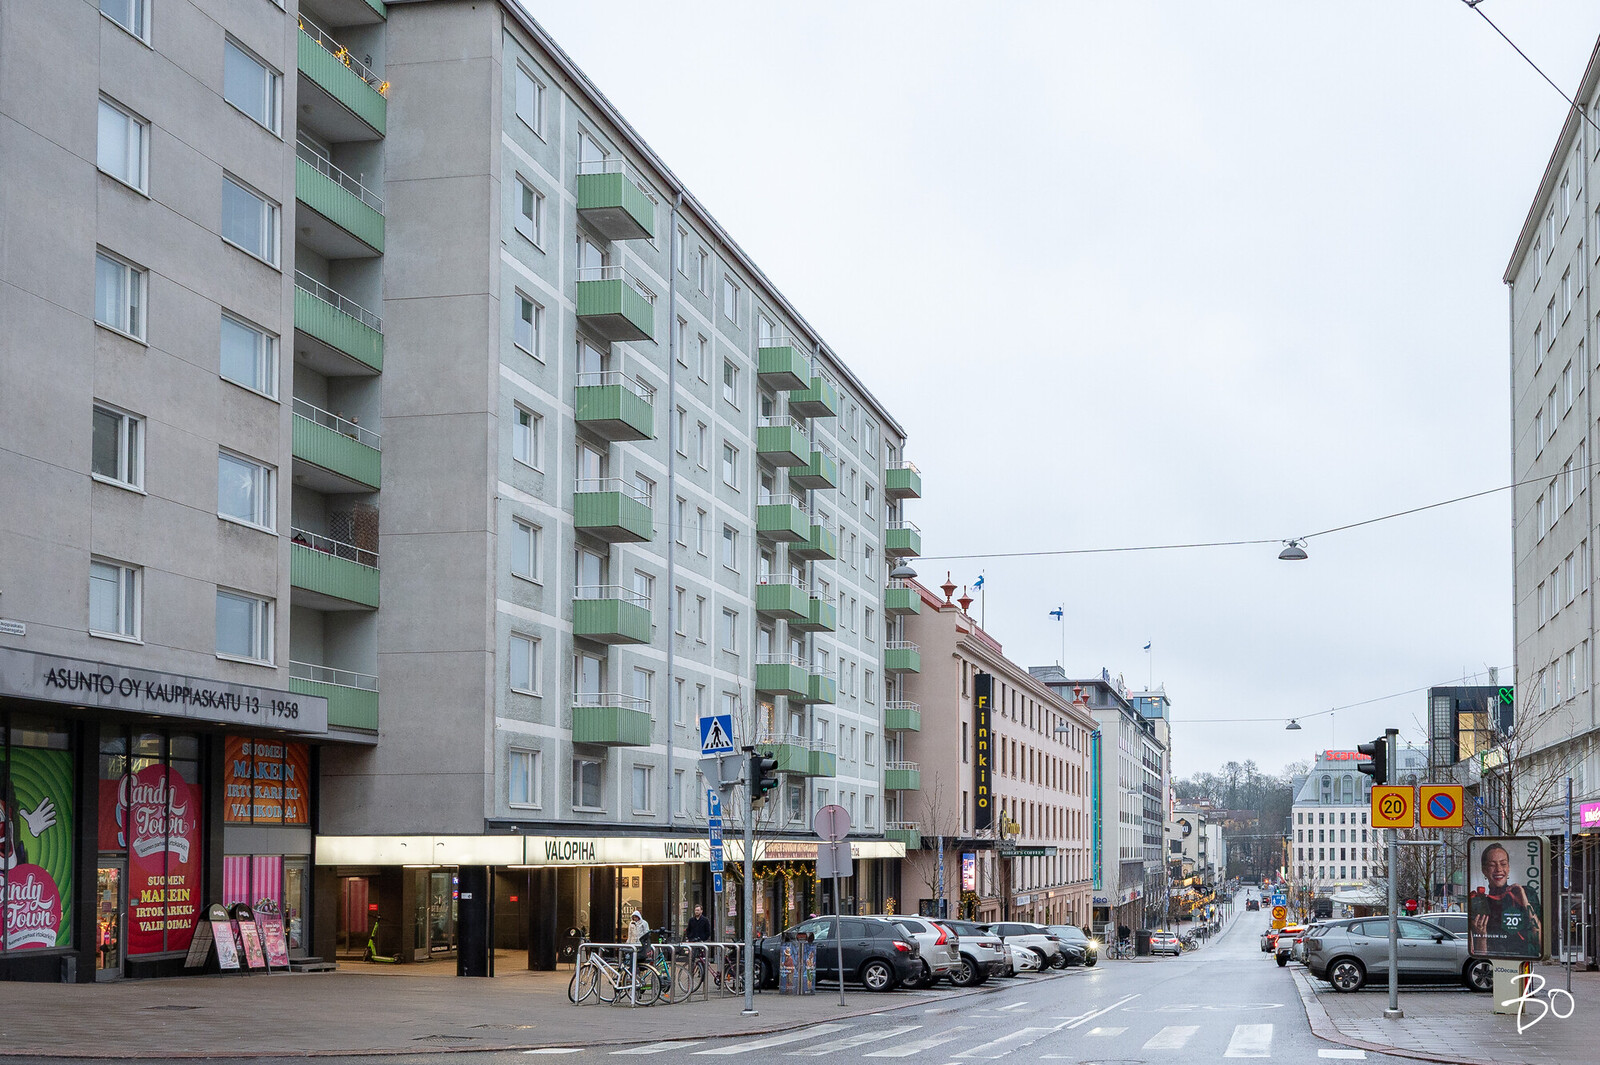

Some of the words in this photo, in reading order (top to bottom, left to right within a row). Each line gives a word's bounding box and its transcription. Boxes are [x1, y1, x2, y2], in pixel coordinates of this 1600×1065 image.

[45, 667, 114, 695] ASUNTO
[119, 678, 142, 698] OY
[146, 681, 240, 712] KAUPPIASKATU
[246, 696, 260, 715] 13
[271, 699, 299, 719] 1958
[978, 695, 988, 808] Finnkino
[233, 760, 296, 781] MAKEIN
[1384, 800, 1402, 814] 20
[136, 806, 186, 834] Town
[545, 840, 596, 861] VALOPIHA
[664, 842, 701, 858] VALOPIHA
[140, 888, 191, 903] MAKEIN
[7, 903, 54, 929] Town
[1494, 966, 1519, 974] JCDecaux
